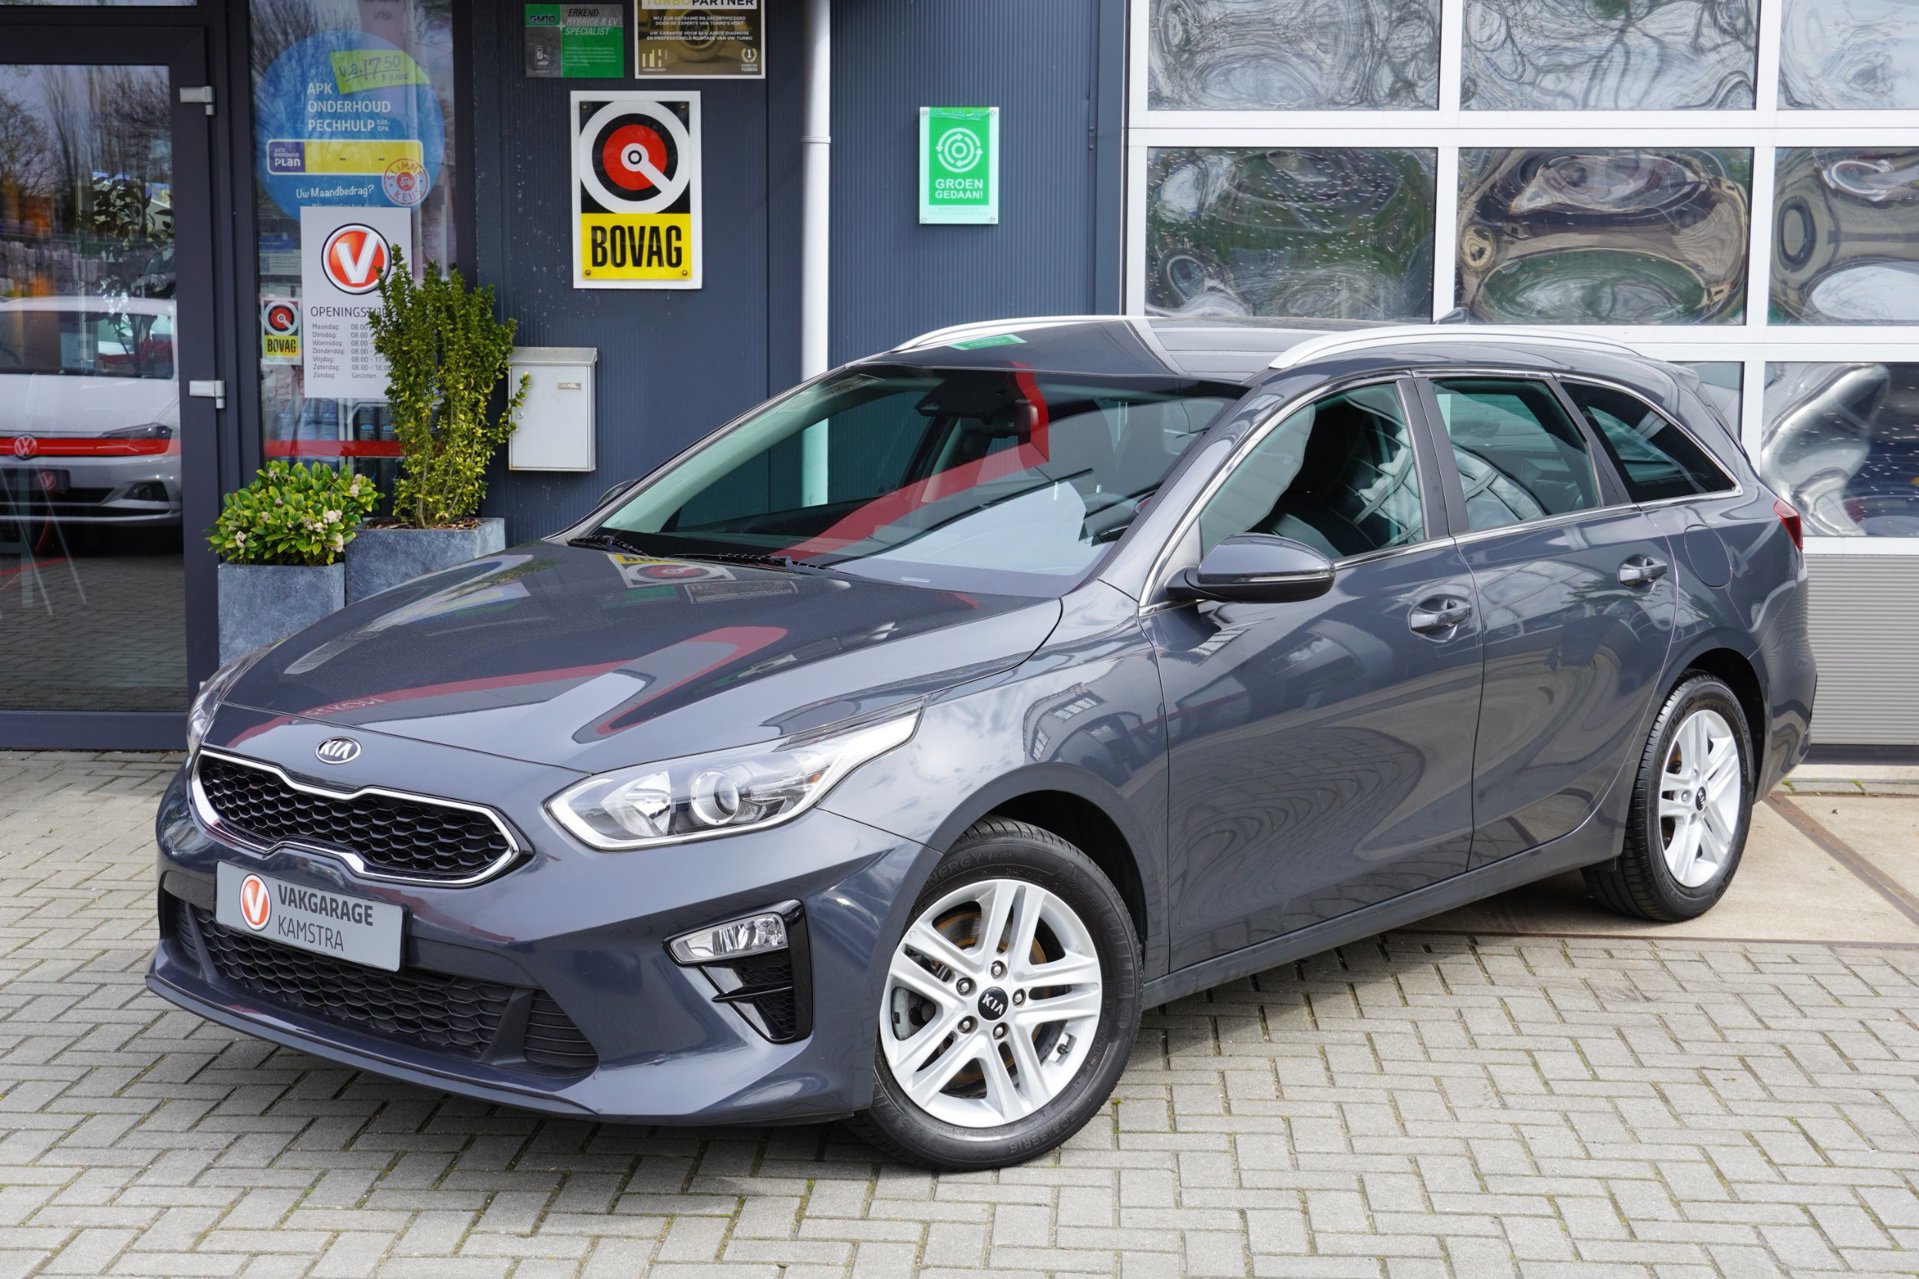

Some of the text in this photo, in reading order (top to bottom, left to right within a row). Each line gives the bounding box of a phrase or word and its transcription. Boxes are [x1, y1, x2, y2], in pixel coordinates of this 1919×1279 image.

[568, 8, 599, 17] ERKEND
[566, 17, 599, 26] HYBRIDE
[608, 17, 618, 25] EV
[565, 27, 610, 36] SPECIALIST
[307, 83, 333, 94] APK
[307, 100, 391, 113] ONDERHOUD
[307, 119, 375, 131] PECHHULP
[387, 161, 423, 181] SLIMME
[935, 178, 983, 189] GROEN
[296, 184, 375, 198] Uw Maandbedrag?
[935, 190, 983, 199] GEDAAN!
[591, 225, 682, 269] BOVAG
[267, 338, 296, 353] BOVAG
[318, 740, 352, 759] KIA
[277, 884, 374, 927] VAKGARAGE
[277, 915, 344, 952] KAMSTRA
[981, 993, 1004, 1015] KIA
